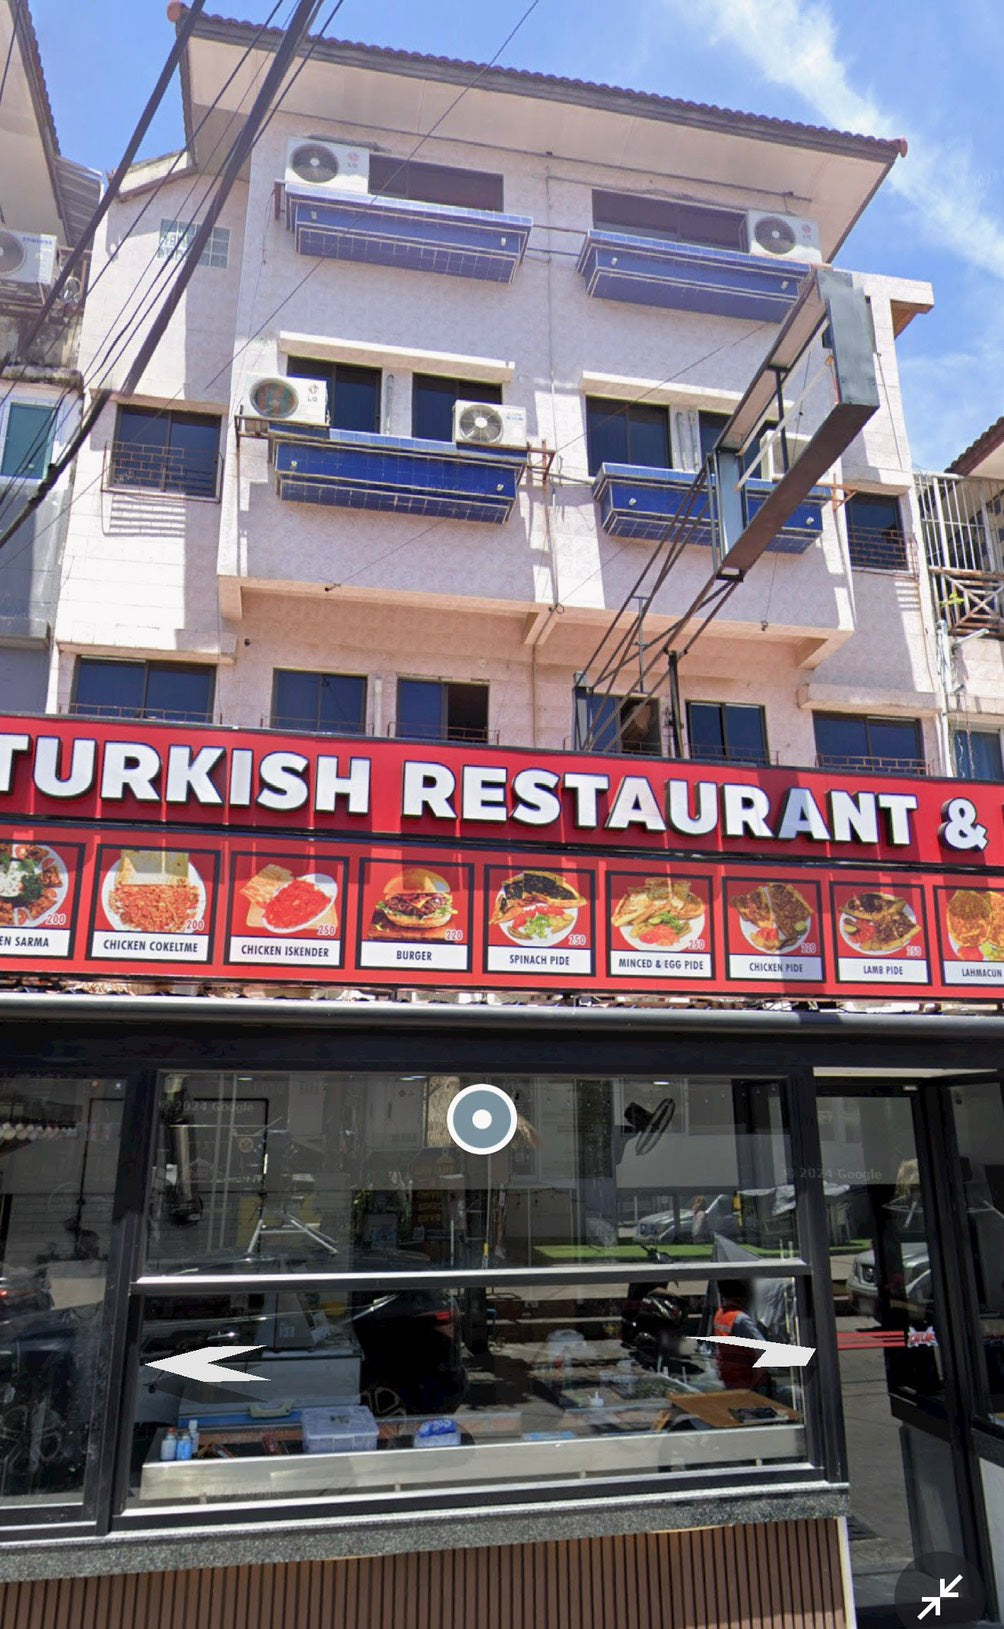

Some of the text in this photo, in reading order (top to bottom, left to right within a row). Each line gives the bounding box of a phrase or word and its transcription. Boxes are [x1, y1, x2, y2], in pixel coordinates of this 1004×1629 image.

[0, 733, 990, 851] TURKISH RESTAURANT &
[45, 913, 66, 925] 200
[186, 919, 205, 931] 200
[317, 925, 336, 936] 250
[445, 929, 463, 941] 220
[15, 936, 49, 947] SARMA
[103, 939, 198, 953] CHICKEN COKELTME
[568, 934, 586, 946] 250
[688, 939, 705, 950] 250
[241, 944, 329, 958] CHICKEN ISKENDER
[396, 950, 432, 961] BURGER
[509, 954, 570, 966] SPINACH PIDE
[618, 958, 704, 970] MINCED & EGG PIDE
[749, 962, 804, 973] CHICKEN PIDE
[863, 965, 904, 976] LAMB PIDE
[961, 968, 1003, 978] LAHMACUN
